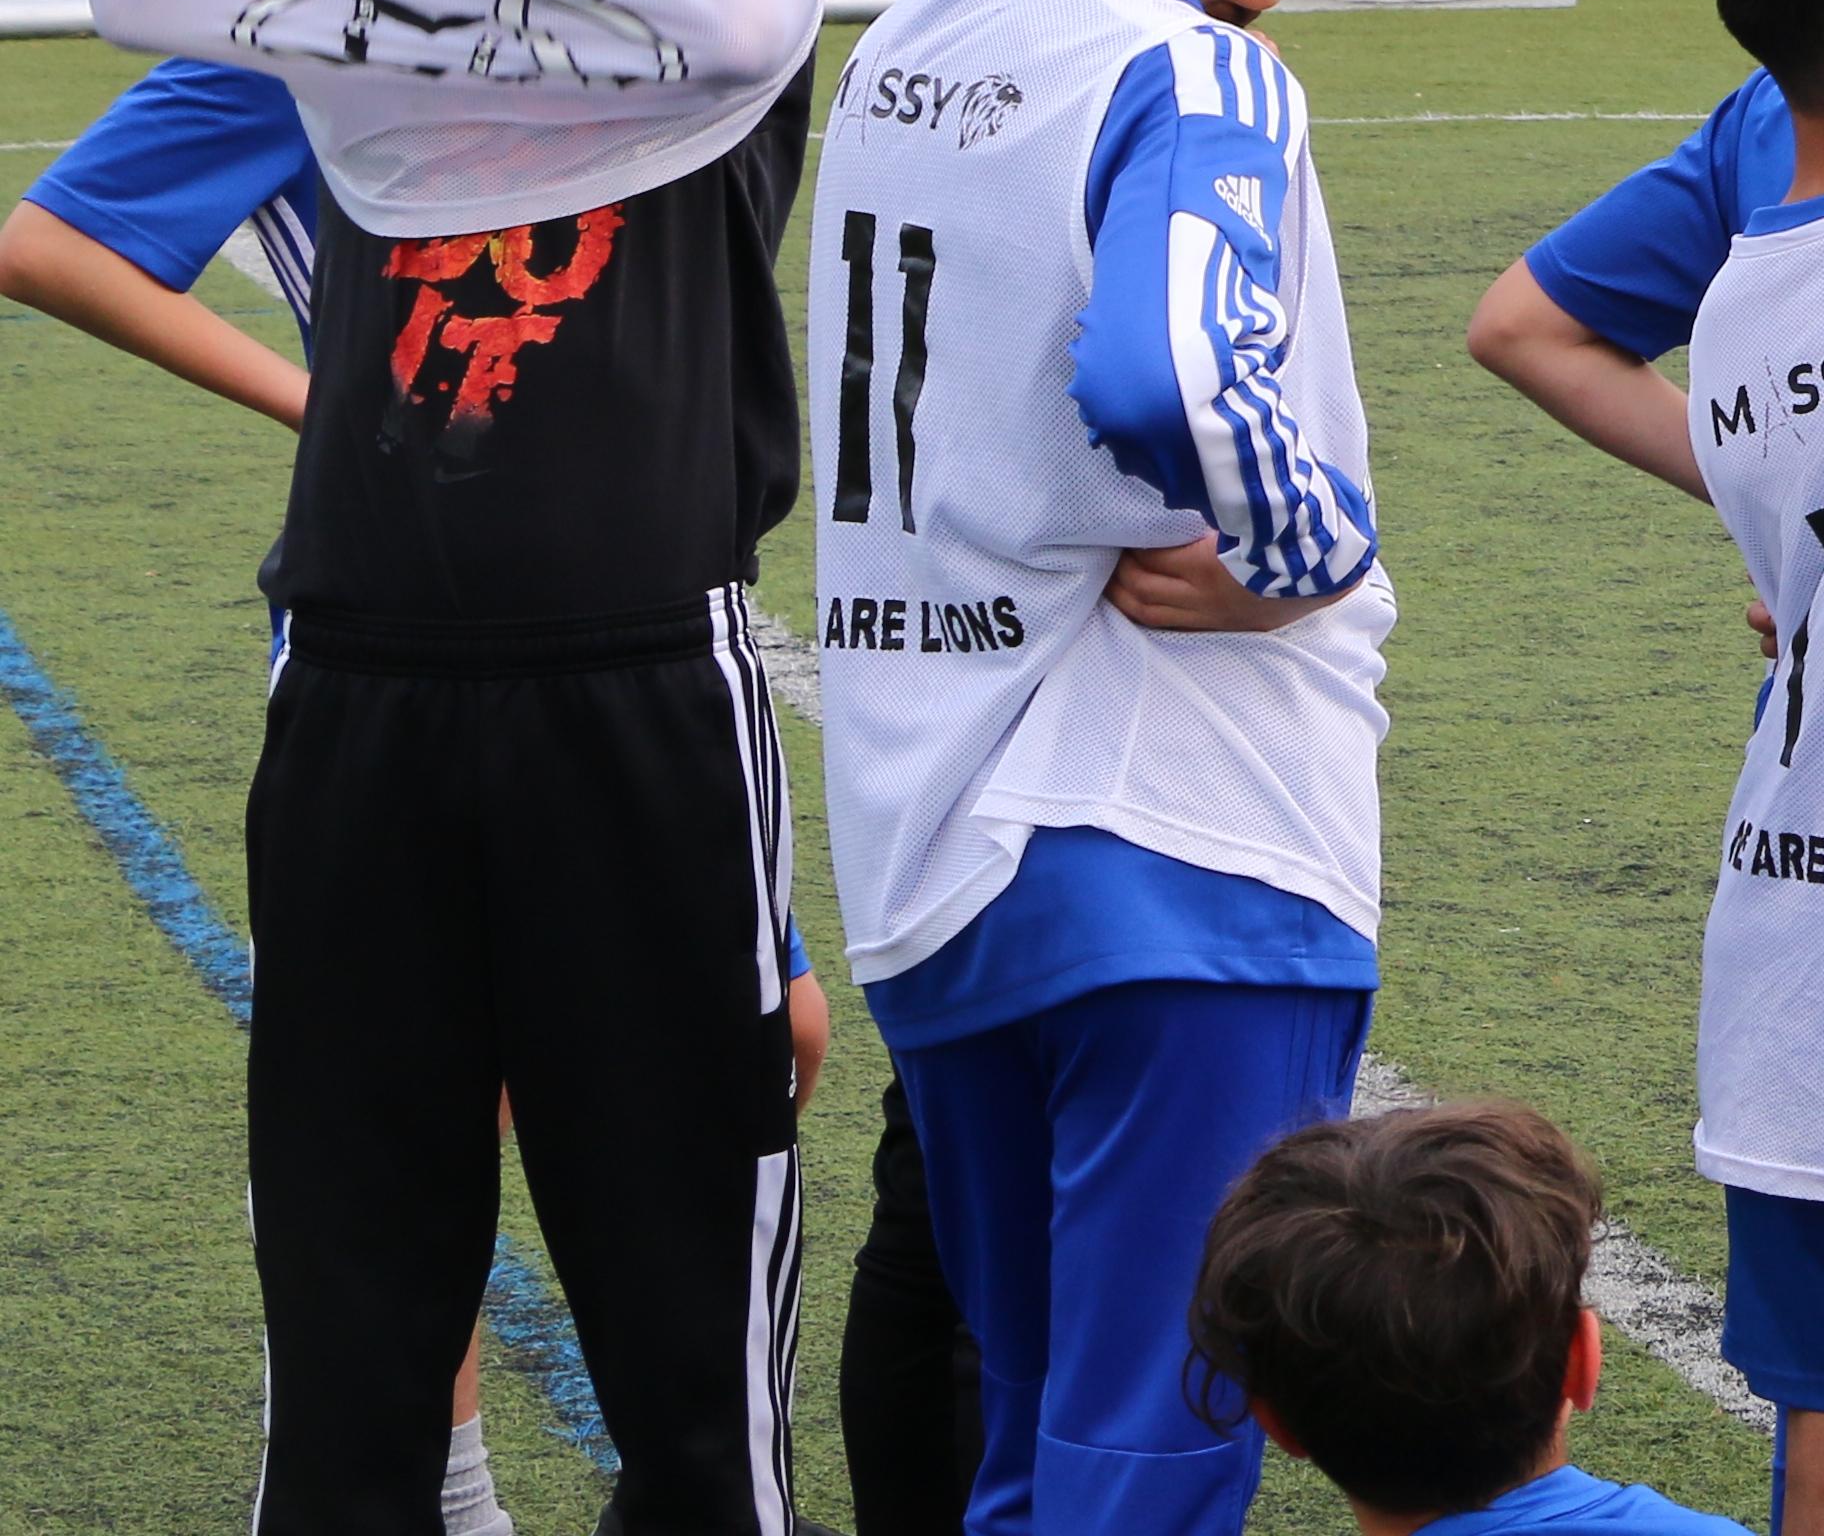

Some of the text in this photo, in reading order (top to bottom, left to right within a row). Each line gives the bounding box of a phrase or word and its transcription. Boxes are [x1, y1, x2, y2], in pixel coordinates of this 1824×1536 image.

[833, 210, 936, 535] 11
[824, 596, 1025, 653] ARE LIONS
